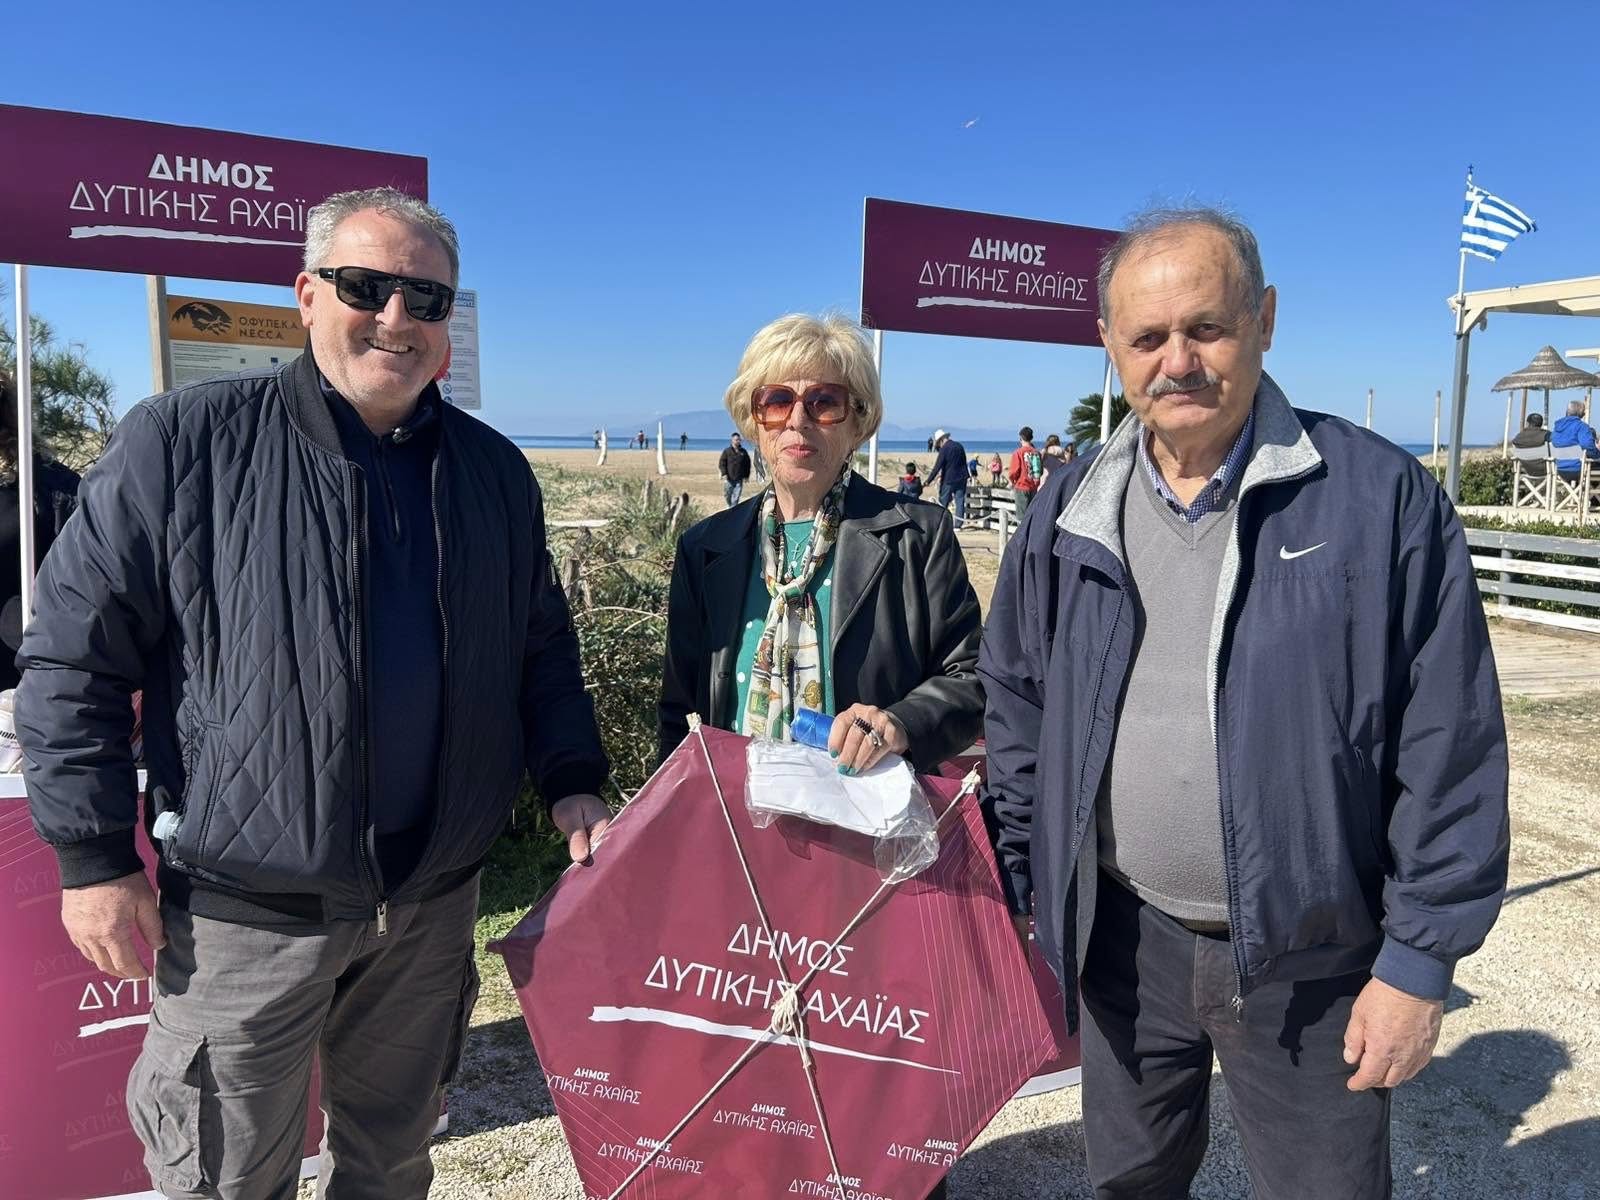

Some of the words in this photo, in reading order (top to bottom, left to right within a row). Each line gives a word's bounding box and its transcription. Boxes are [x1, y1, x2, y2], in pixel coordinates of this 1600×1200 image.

[148, 153, 274, 192] ΔΗΜΟΣ
[69, 181, 218, 223] ΔΥΤΙΚΗΣ
[230, 198, 315, 232] ΑΧΑΪ
[968, 237, 1046, 266] ΔΗΜΟΣ
[919, 260, 1009, 293] ΔΥΤΙΚΗΣ
[1015, 271, 1089, 301] ΑΧΑΪΑΣ
[727, 923, 854, 976] ΔΗΜΟΣ
[801, 989, 930, 1043] ΑΧΑΪΑΣ
[574, 1067, 611, 1082] ΔΗΜΟΣ
[593, 1084, 642, 1105] ΑΧΑΪΑΣ
[751, 1102, 787, 1117] ΔΗΜΟΣ
[713, 1109, 769, 1131] ΔΥΤΙΚΗΣ
[770, 1119, 818, 1140] ΑΧΑΪΑΣ
[886, 1142, 942, 1165] ΔΥΤΙΚΗΣ
[924, 1138, 959, 1152] ΔΗΜΟΣ
[655, 1154, 704, 1175] ΑΧΑΪΑΣ
